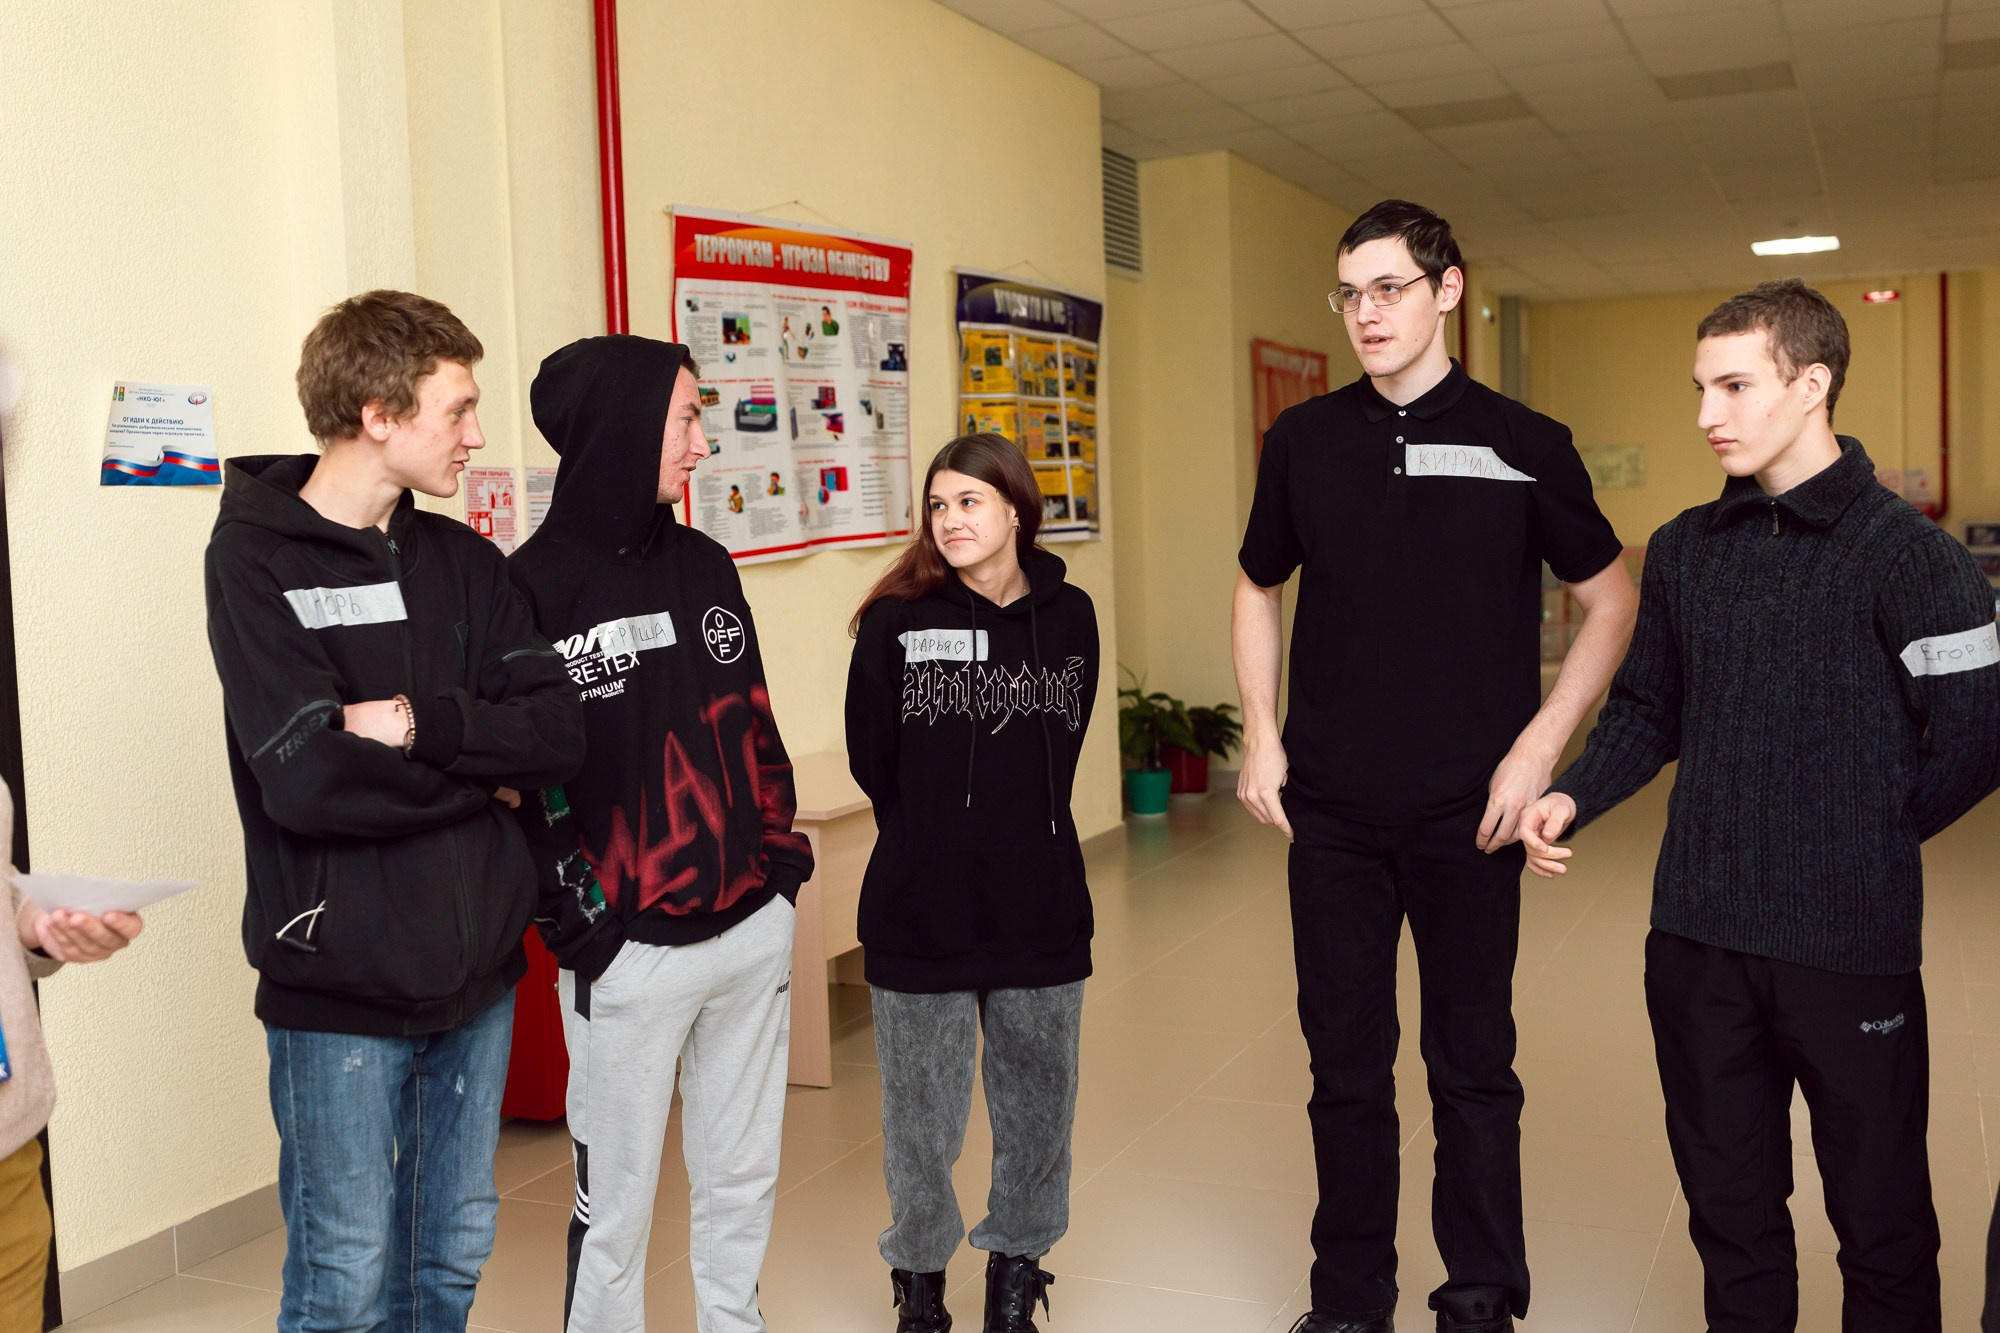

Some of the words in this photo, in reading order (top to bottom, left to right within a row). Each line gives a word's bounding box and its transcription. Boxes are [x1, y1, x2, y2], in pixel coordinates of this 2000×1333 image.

[694, 233, 774, 268] ТЕРРОРИЗМ
[781, 243, 827, 275] УГРОЗА
[827, 249, 890, 282] ОБЩЕСТВУ
[151, 417, 184, 426] ДЕЙСТВИЮ
